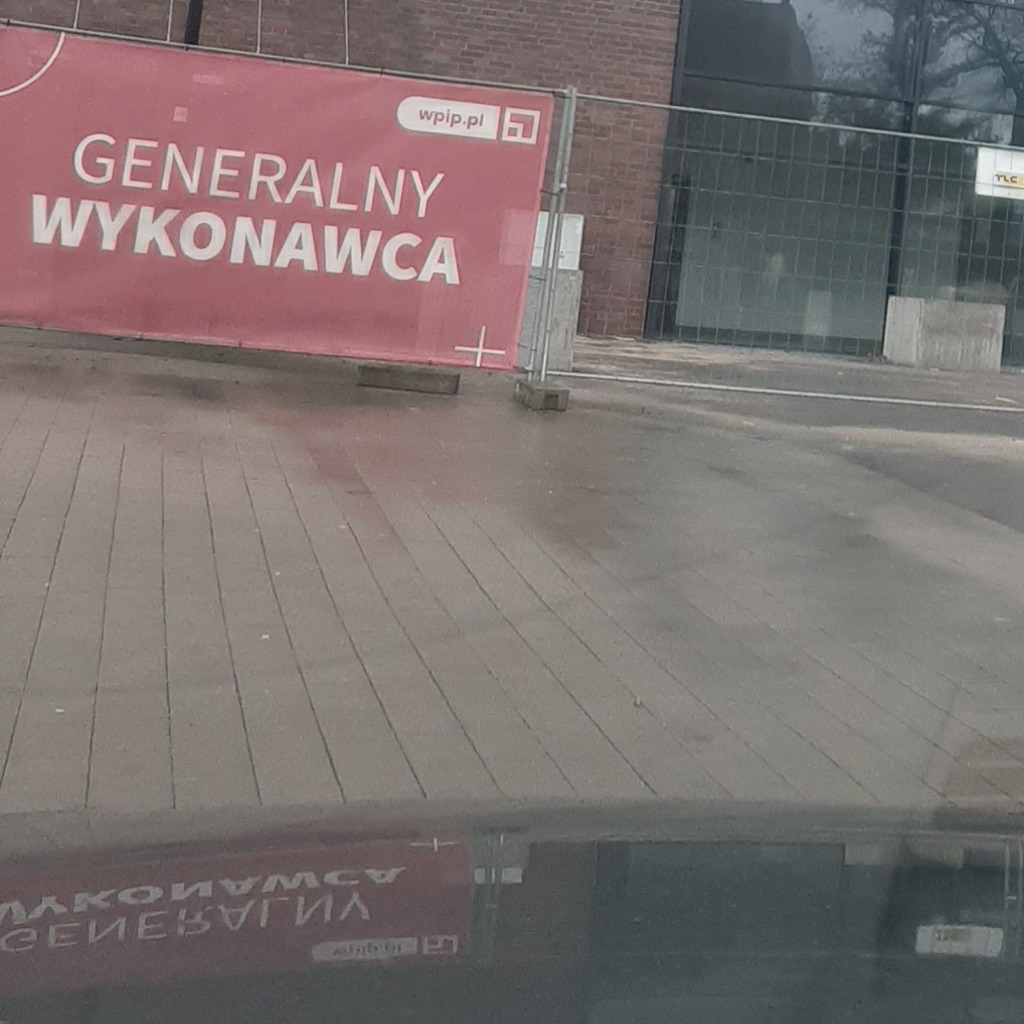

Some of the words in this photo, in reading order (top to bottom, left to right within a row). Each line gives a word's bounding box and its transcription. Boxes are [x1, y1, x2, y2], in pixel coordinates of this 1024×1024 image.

[418, 106, 484, 129] wpip.pl
[73, 133, 445, 219] GENERALNY
[31, 194, 460, 285] WYKONAWCA
